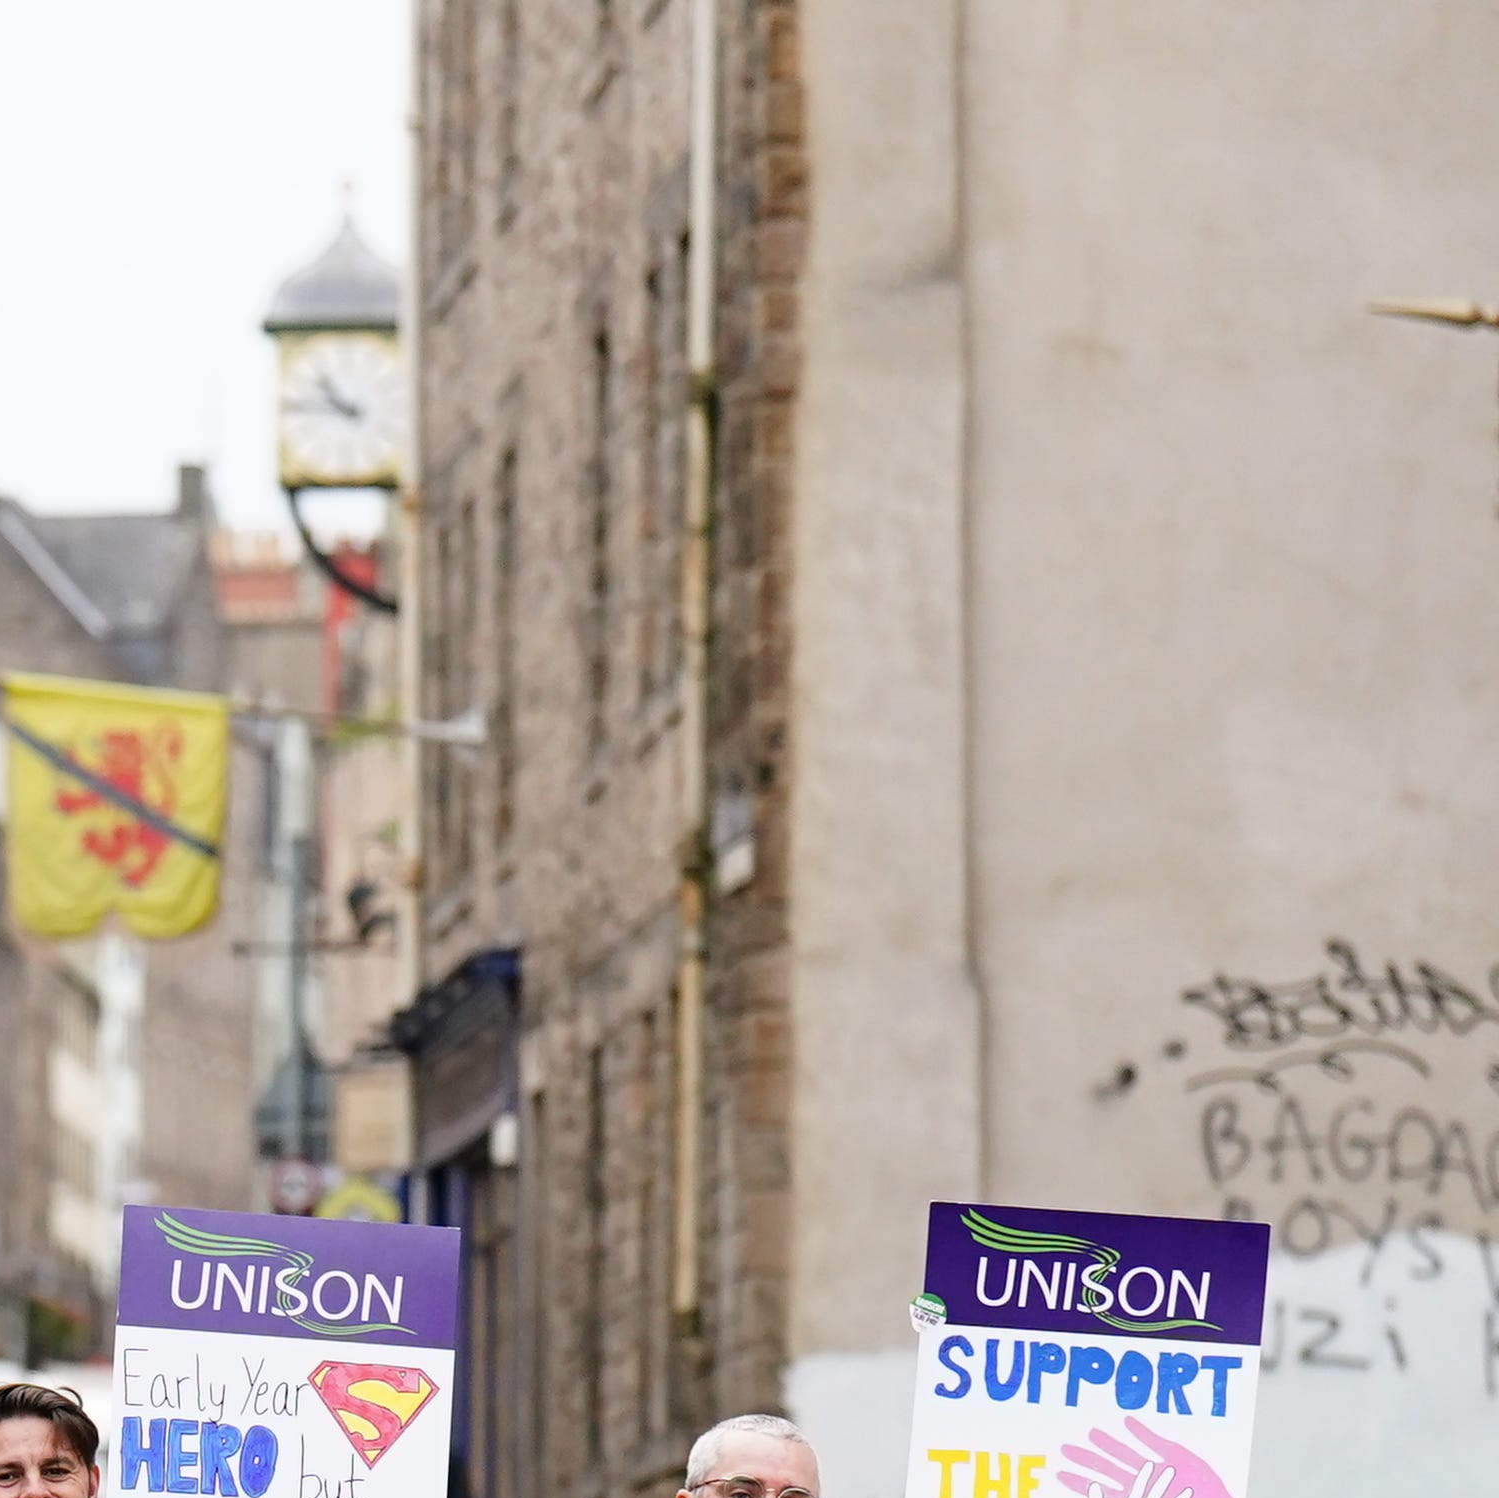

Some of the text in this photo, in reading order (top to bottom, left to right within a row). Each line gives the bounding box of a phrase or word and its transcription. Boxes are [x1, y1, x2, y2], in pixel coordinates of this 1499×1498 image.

[1200, 1093, 1499, 1215] BAGDA
[172, 1259, 403, 1323] UNISON
[977, 1256, 1210, 1320] UNISON
[122, 1346, 228, 1423] Early
[241, 1356, 308, 1417] Year
[935, 1335, 1243, 1416] SUPPORT
[121, 1416, 277, 1498] HERO
